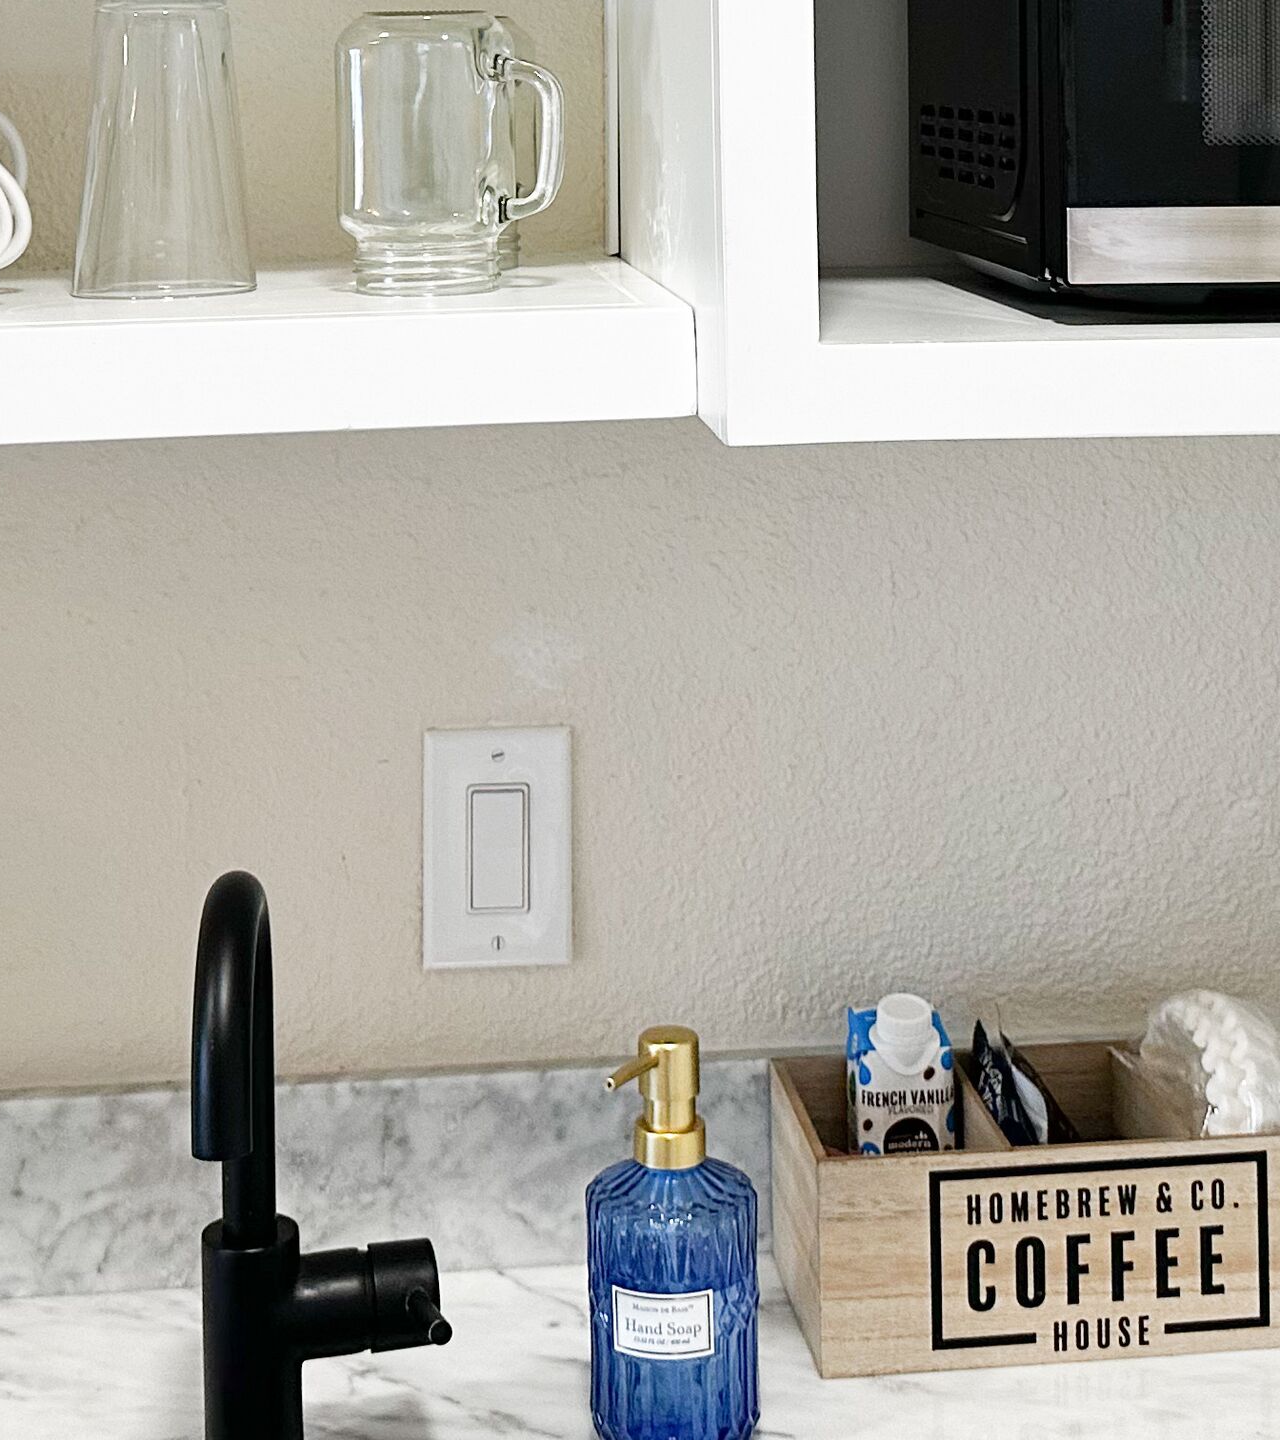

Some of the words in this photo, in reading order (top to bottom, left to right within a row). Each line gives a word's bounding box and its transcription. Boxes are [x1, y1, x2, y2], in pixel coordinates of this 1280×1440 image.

[861, 1089, 907, 1108] FRENCH
[888, 1138, 932, 1150] modern
[966, 1183, 1137, 1226] HOMEBREW
[1156, 1181, 1173, 1214] &
[1190, 1178, 1240, 1212] CO.
[966, 1224, 1226, 1313] COFFEE
[625, 1317, 663, 1336] Hand
[666, 1321, 702, 1338] Soap
[1053, 1315, 1150, 1352] HOUSE
